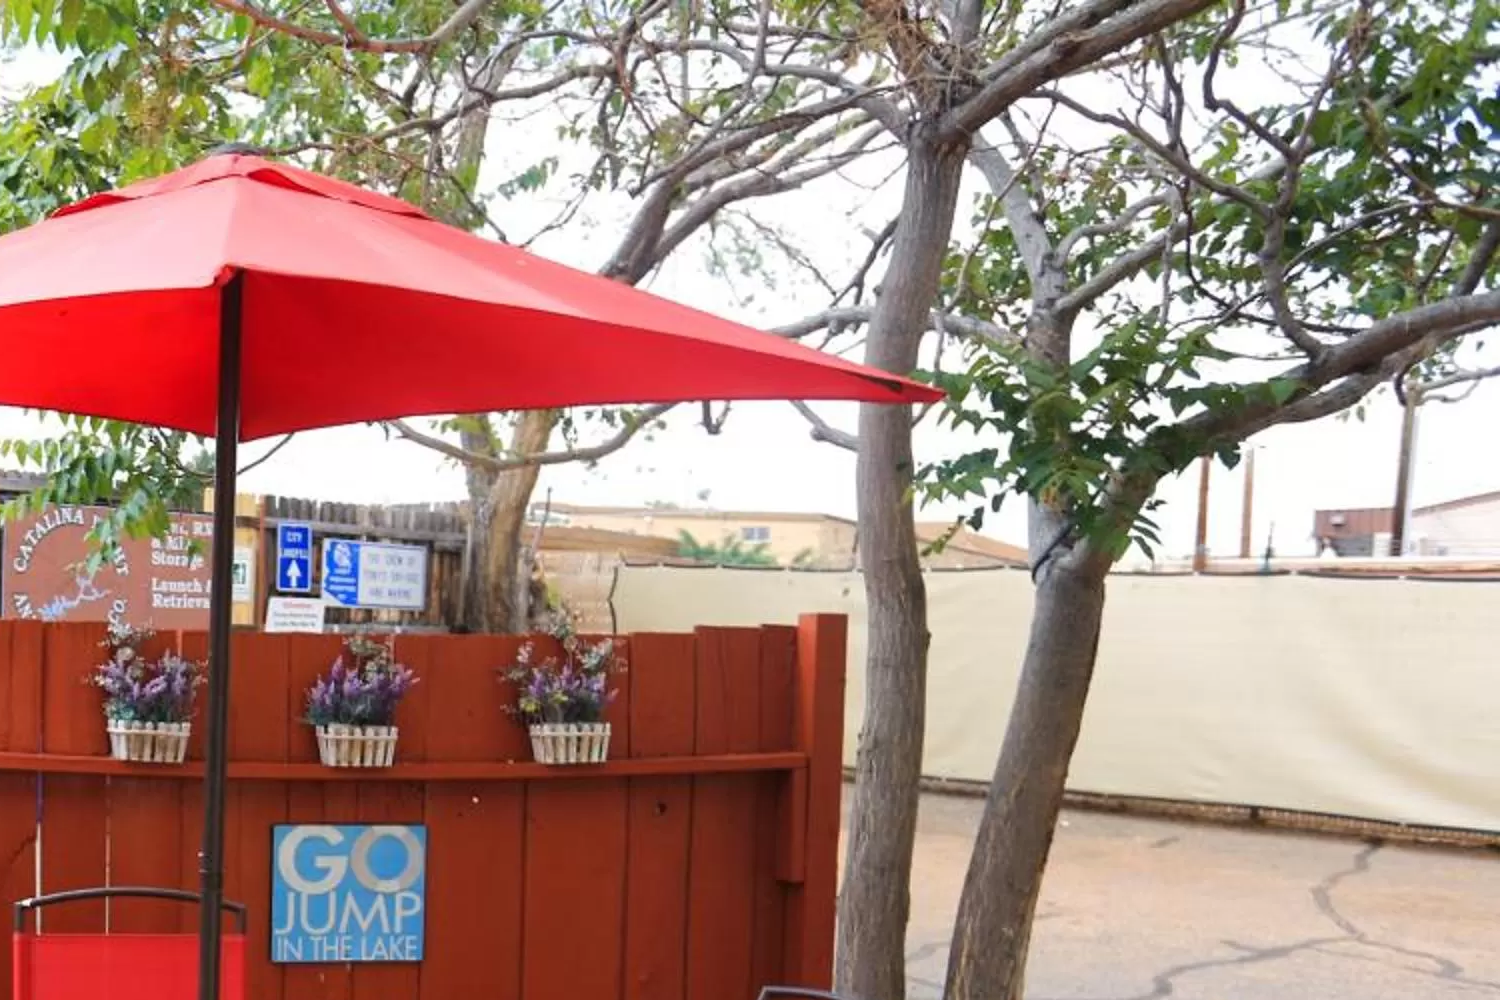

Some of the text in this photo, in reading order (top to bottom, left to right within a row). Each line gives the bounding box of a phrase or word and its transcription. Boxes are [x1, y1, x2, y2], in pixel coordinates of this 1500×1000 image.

[13, 507, 84, 573] CATALINA
[150, 577, 203, 593] Launch
[150, 593, 212, 609] Retrieva
[278, 825, 423, 895] GO
[275, 891, 422, 935] JUMP
[277, 935, 418, 961] IN THE LAKE
